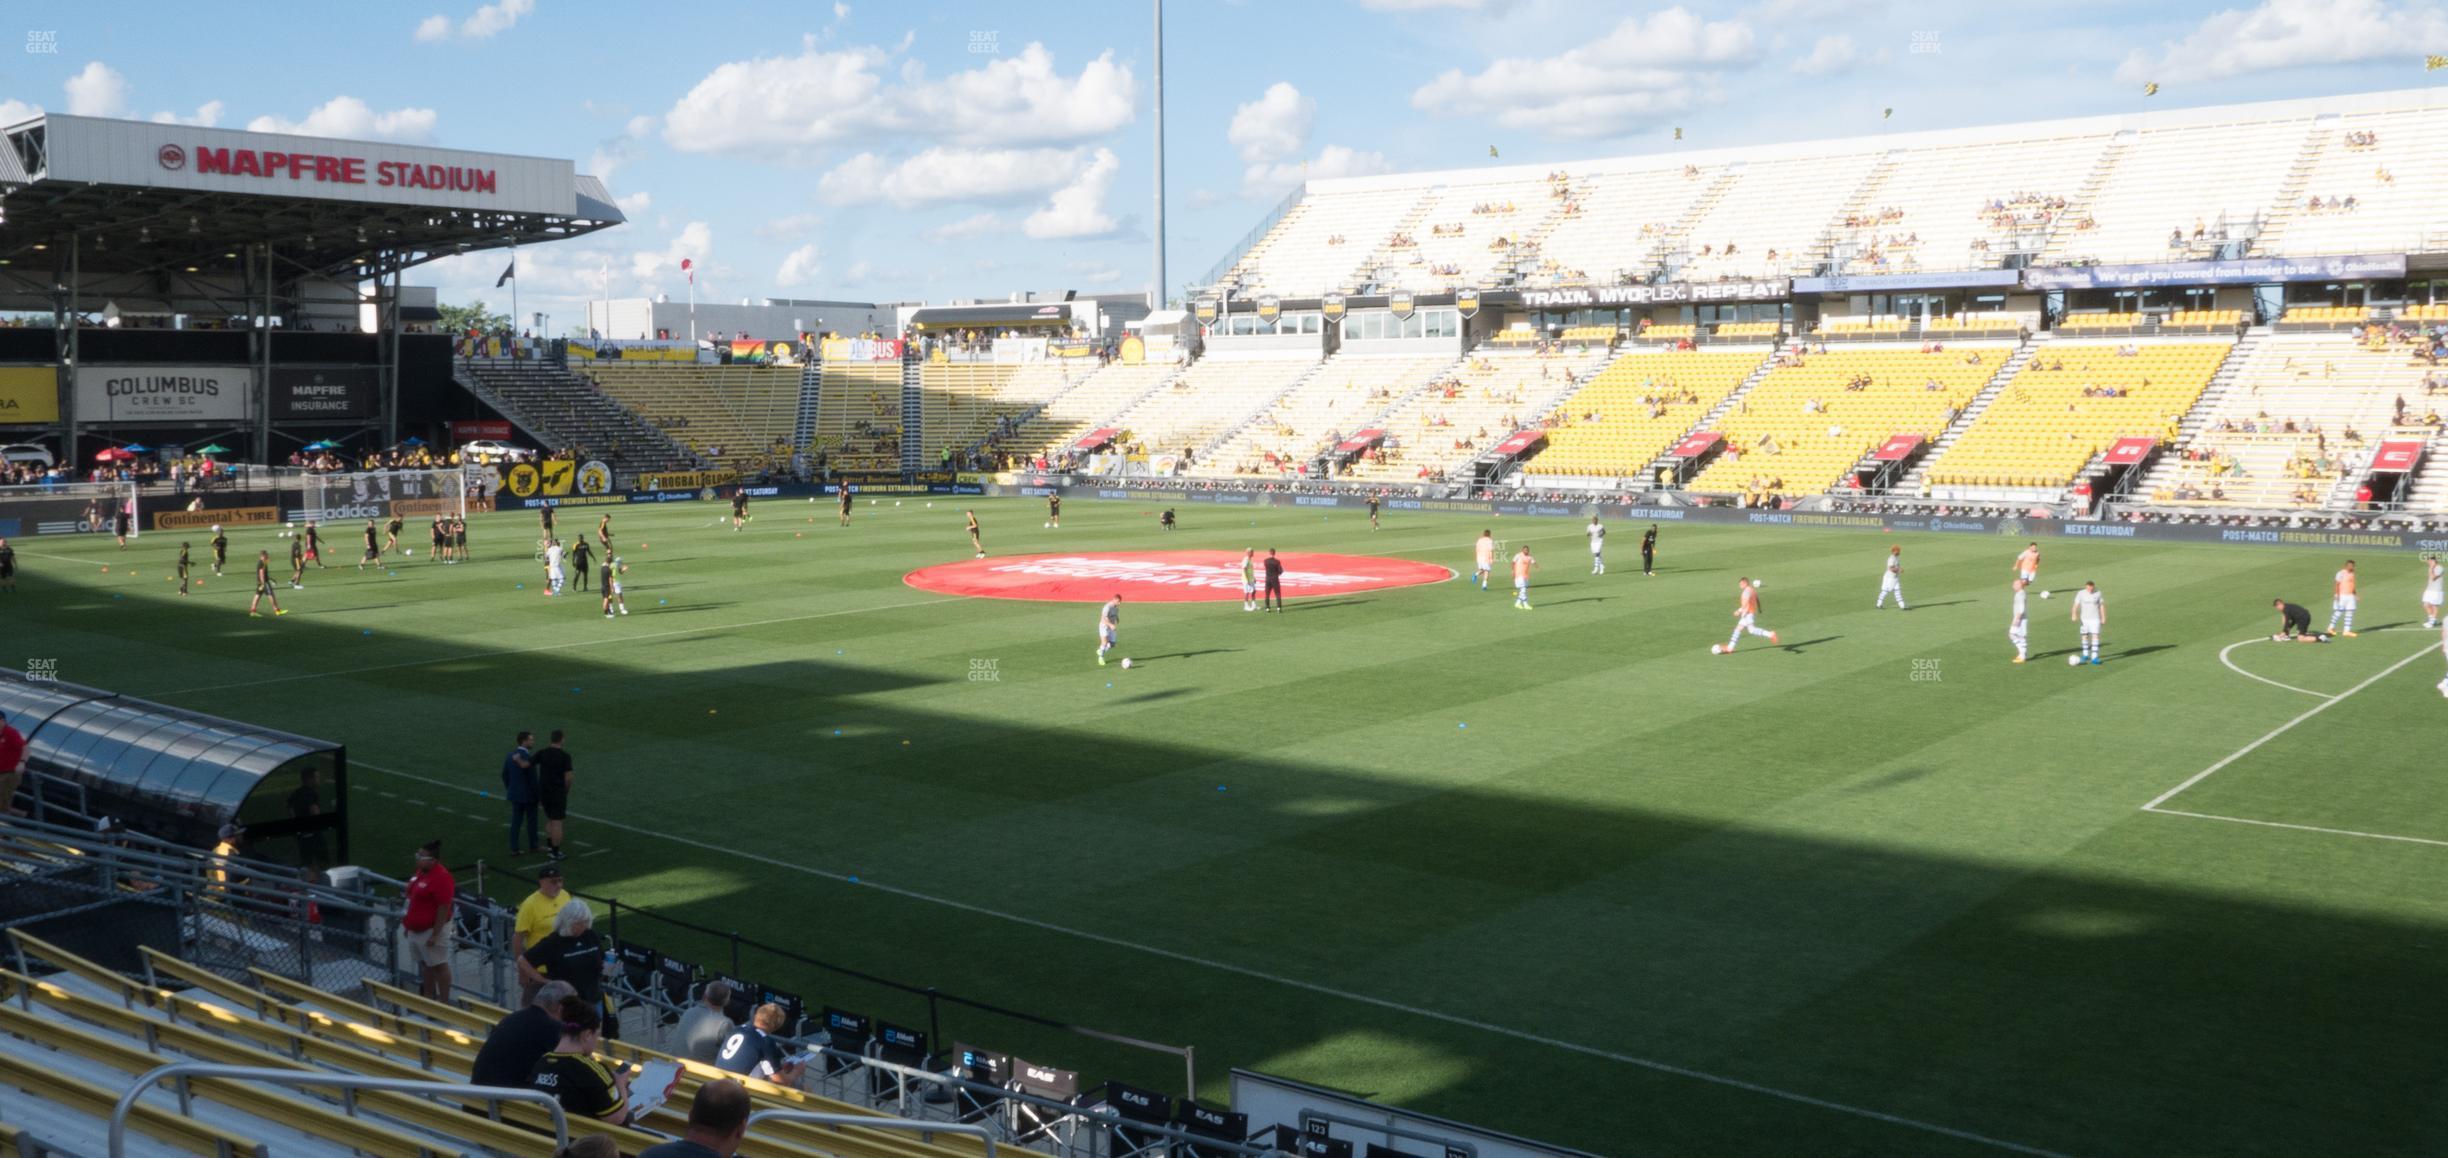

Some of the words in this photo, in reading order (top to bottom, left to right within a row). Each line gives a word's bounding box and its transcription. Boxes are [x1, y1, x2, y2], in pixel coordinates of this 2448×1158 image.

[196, 146, 366, 184] MAPFRE
[376, 161, 496, 194] STADIUM
[2130, 270, 2149, 285] got
[2151, 270, 2171, 284] you
[2173, 268, 2214, 280] covered
[2215, 266, 2242, 279] from
[2244, 264, 2282, 277] header
[2284, 265, 2296, 275] to
[2298, 264, 2317, 274] toe
[1522, 290, 1593, 305] TRAIN.
[1600, 286, 1687, 303] MYOPLEX.
[1693, 282, 1786, 299] REPEAT.
[106, 376, 219, 397] COLUMBUS
[292, 385, 347, 395] MAPFRE
[132, 396, 172, 406] CREW
[178, 396, 196, 406] SC
[291, 400, 349, 410] INSURANCE
[325, 504, 380, 519] adidas
[1388, 500, 1421, 510] POST-MATCH
[159, 508, 232, 529] Continental
[246, 511, 273, 521] TIRE
[1631, 508, 1650, 518] NEXT
[1650, 510, 1684, 520] SATURDAY
[1750, 512, 1792, 524] POST-MATCH
[1792, 514, 1828, 525] FIREWORK
[1830, 515, 1884, 526] EXTRAVAGANZA
[2065, 524, 2087, 535] NEXT
[2088, 525, 2136, 536] SATURDAY
[2222, 530, 2278, 542] POST-MATCH
[2280, 531, 2327, 544] FIREWORK
[2329, 534, 2402, 546] EXTRAVAGANZA
[722, 1033, 744, 1060] 9
[1027, 1066, 1056, 1083] EAS
[1122, 1090, 1149, 1106] EAS
[1195, 1108, 1224, 1126] EAS
[1310, 1123, 1326, 1136] 123
